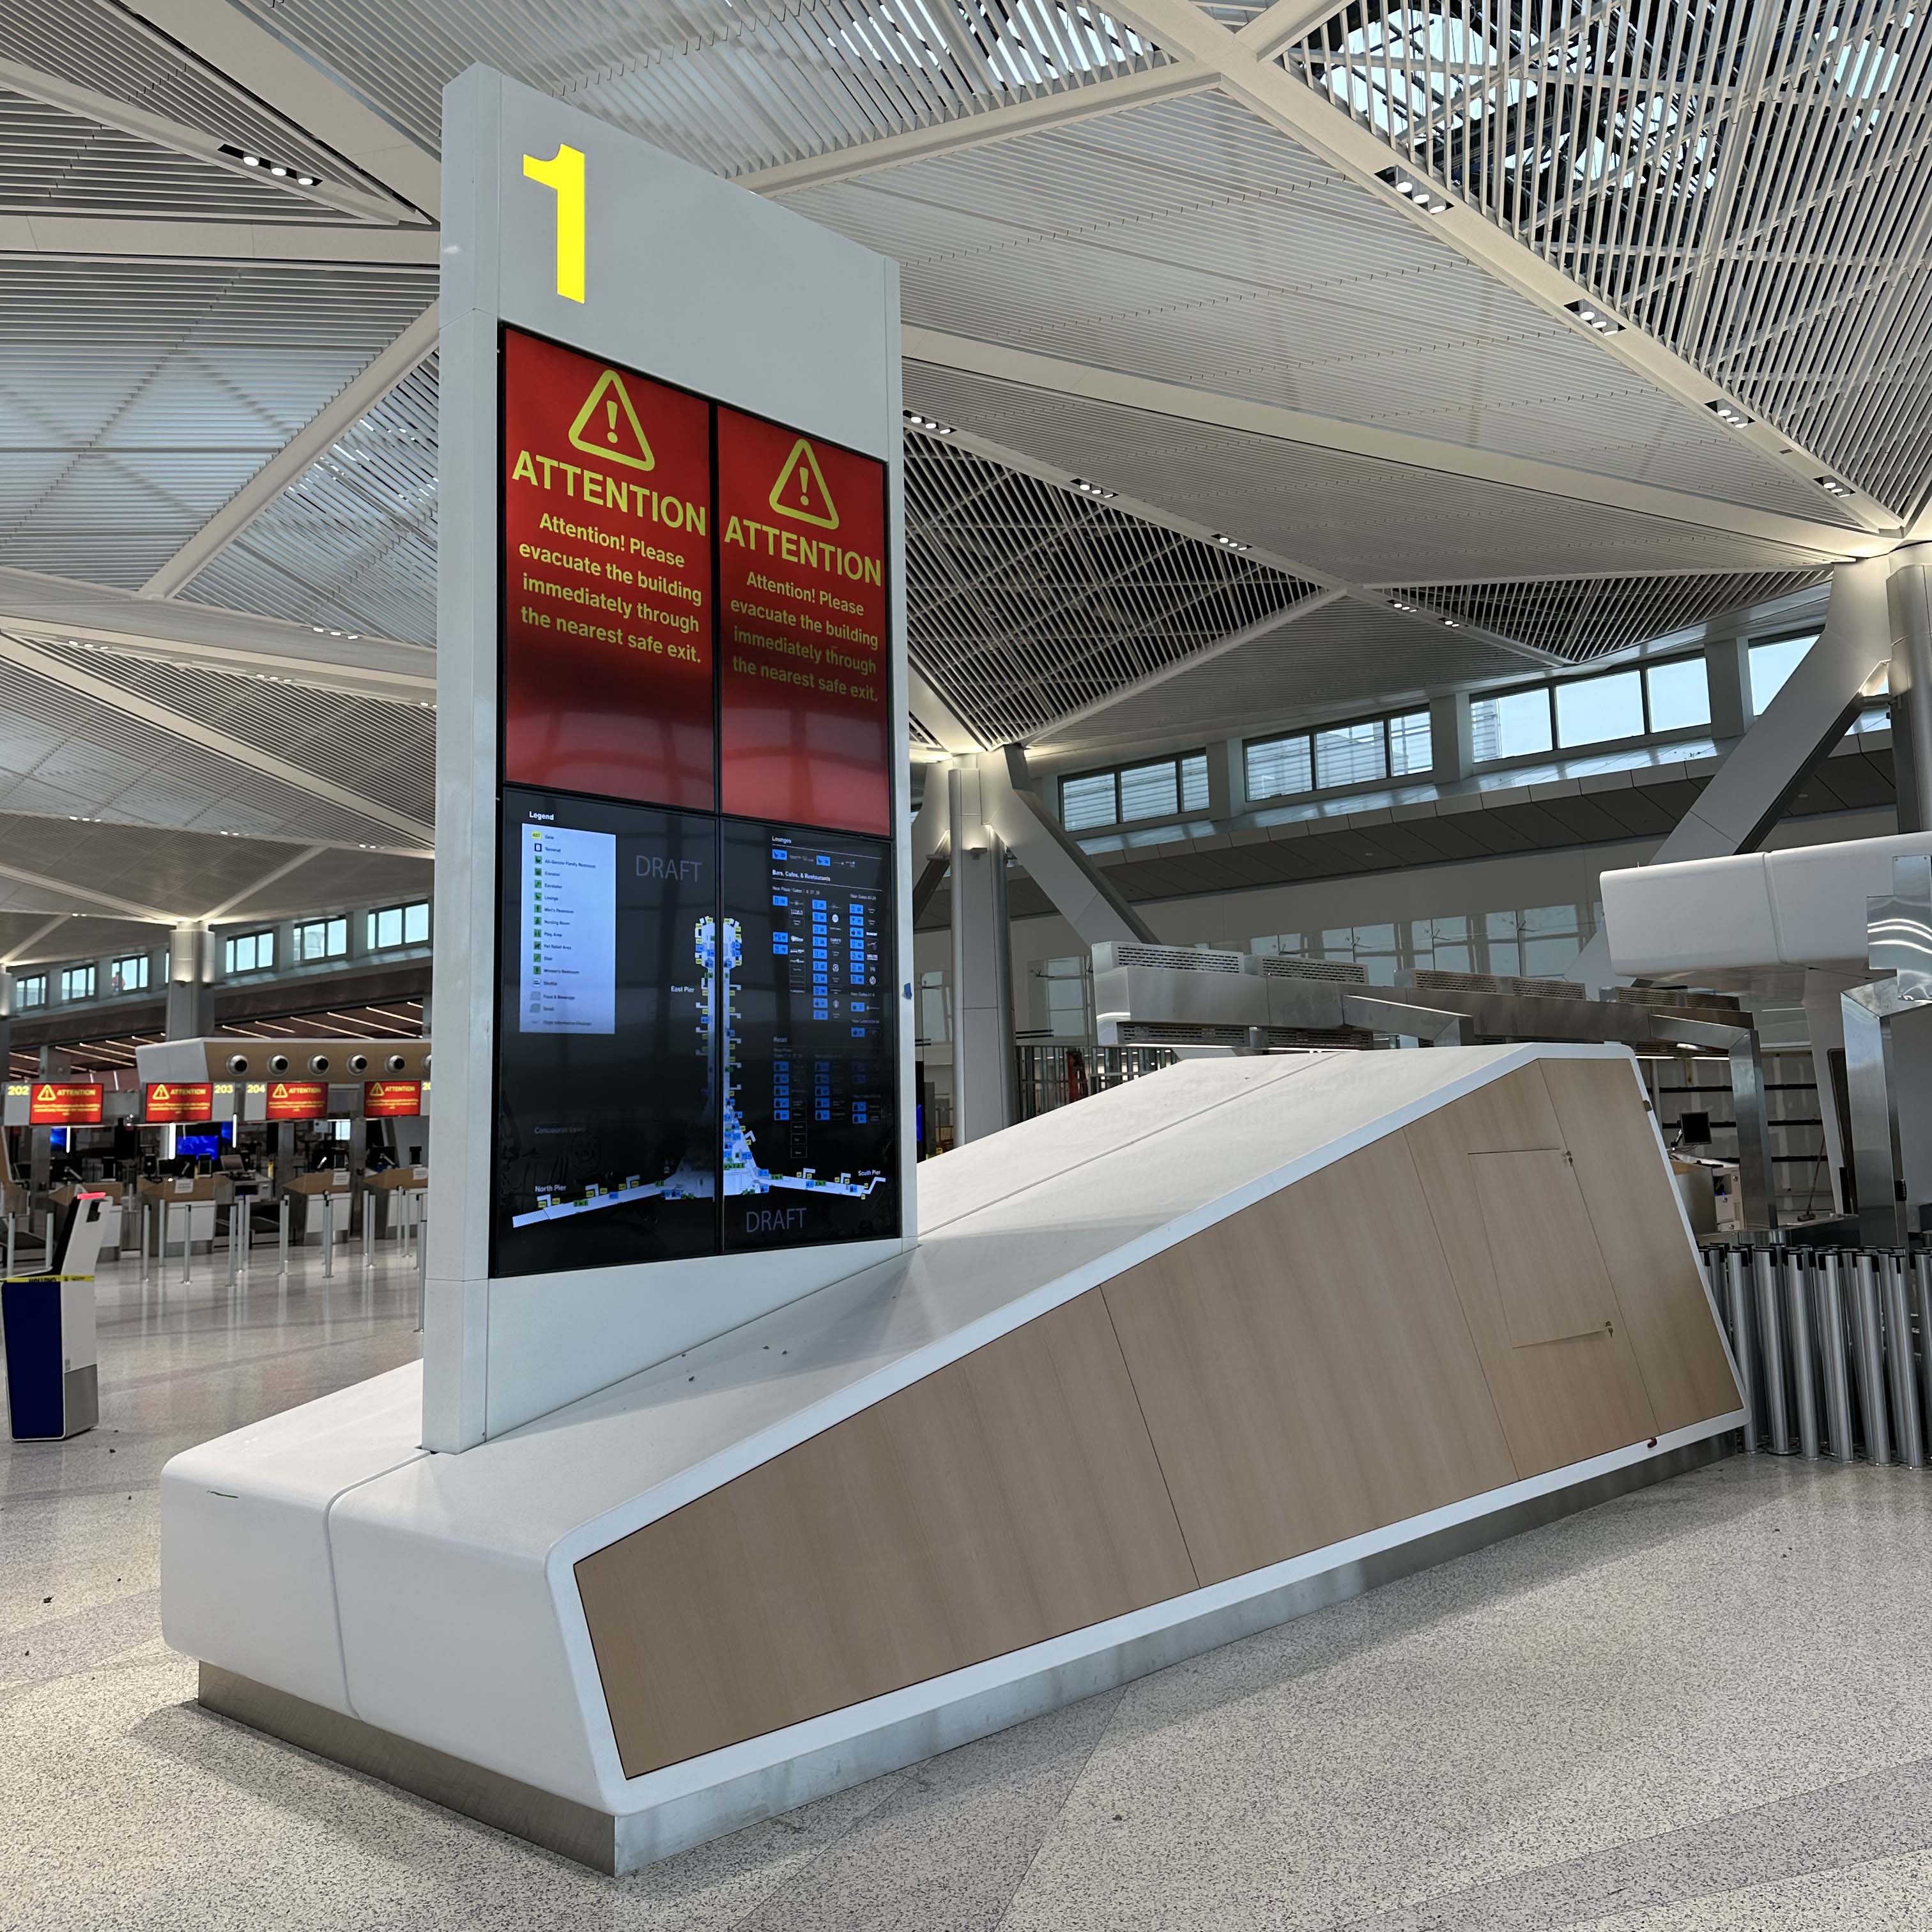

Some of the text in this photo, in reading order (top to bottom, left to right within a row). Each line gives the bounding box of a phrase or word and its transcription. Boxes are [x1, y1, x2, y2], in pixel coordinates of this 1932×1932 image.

[523, 143, 585, 304] 1
[512, 450, 705, 536] ATTENTION
[539, 513, 685, 568] Attention! Please
[724, 516, 881, 586] ATTENTION
[519, 543, 702, 606] evacuate the building
[746, 571, 864, 616] Attention! Please
[523, 572, 699, 634] immediately through
[731, 600, 878, 650] evacuate the building
[521, 606, 701, 663] the nearest safe exit.
[734, 625, 876, 675] immediately through
[733, 656, 878, 702] the nearest safe exit.
[529, 811, 554, 820] Legend
[772, 836, 792, 844] Lounges
[636, 855, 702, 882] DRAFT
[804, 873, 831, 882] Restaurants
[8, 1085, 29, 1096] 202
[214, 1084, 233, 1094] 203
[247, 1084, 266, 1094] 204
[746, 1208, 807, 1232] DRAFT
